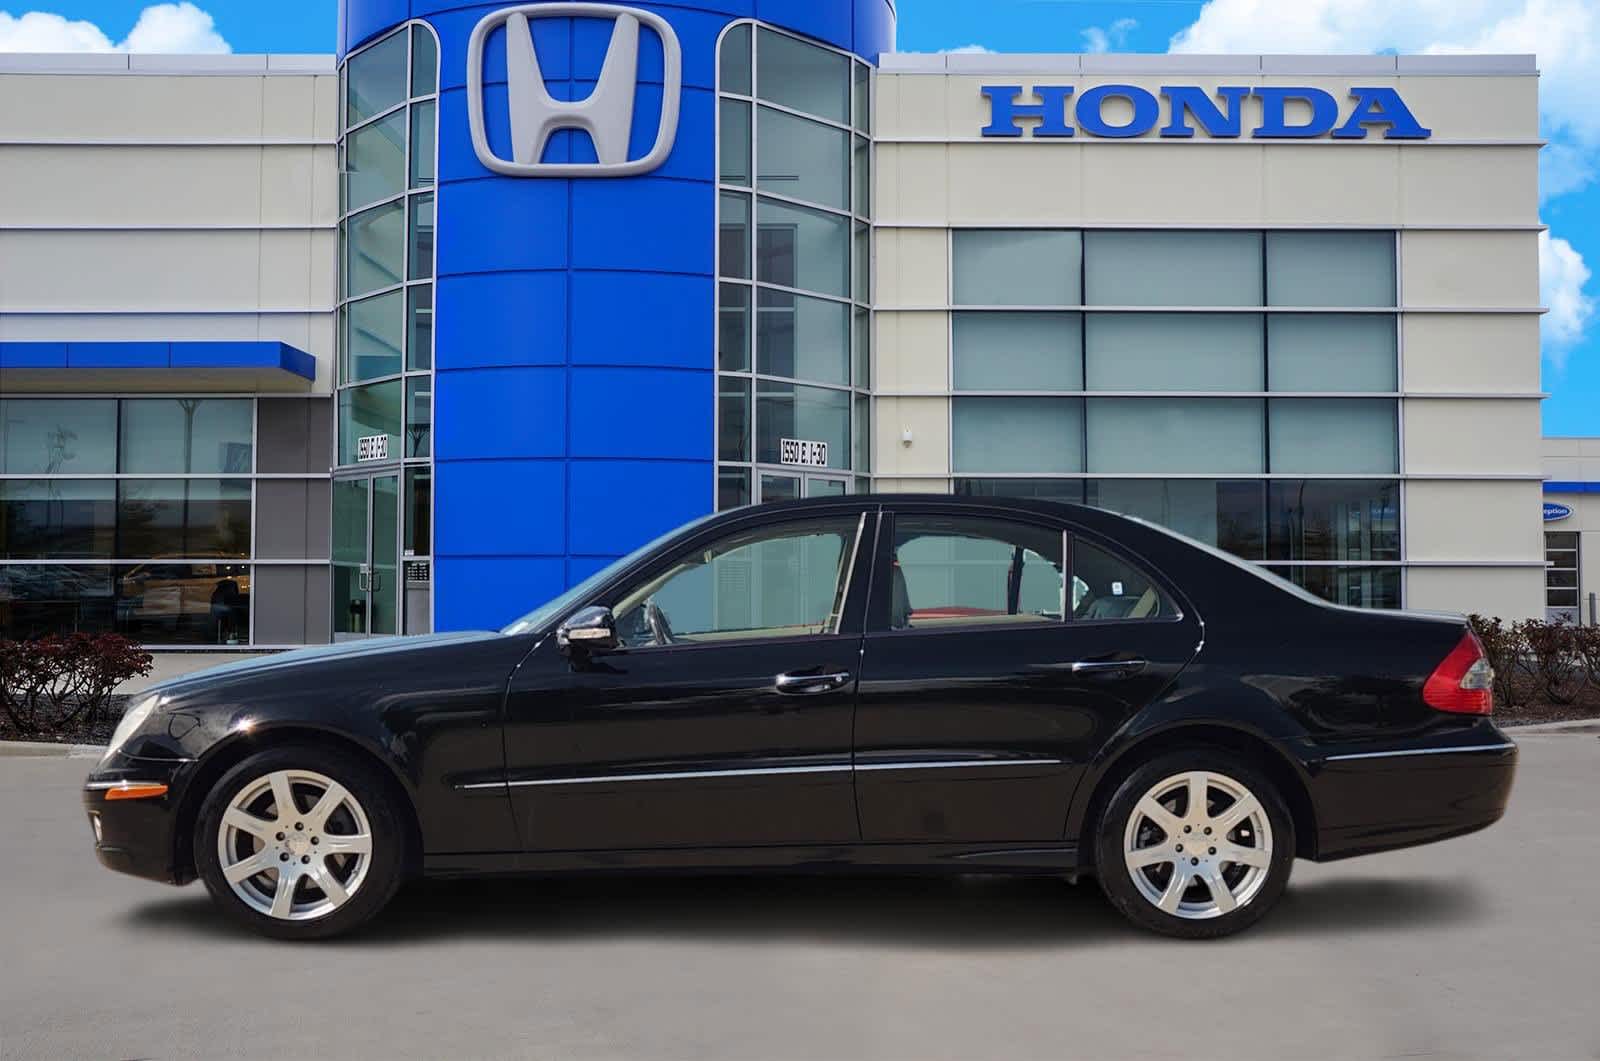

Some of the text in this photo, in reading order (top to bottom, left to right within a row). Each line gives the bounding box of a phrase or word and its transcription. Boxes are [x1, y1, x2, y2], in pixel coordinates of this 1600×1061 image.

[981, 85, 1432, 138] HONDA
[782, 439, 799, 463] 1550
[810, 443, 826, 465] I-30
